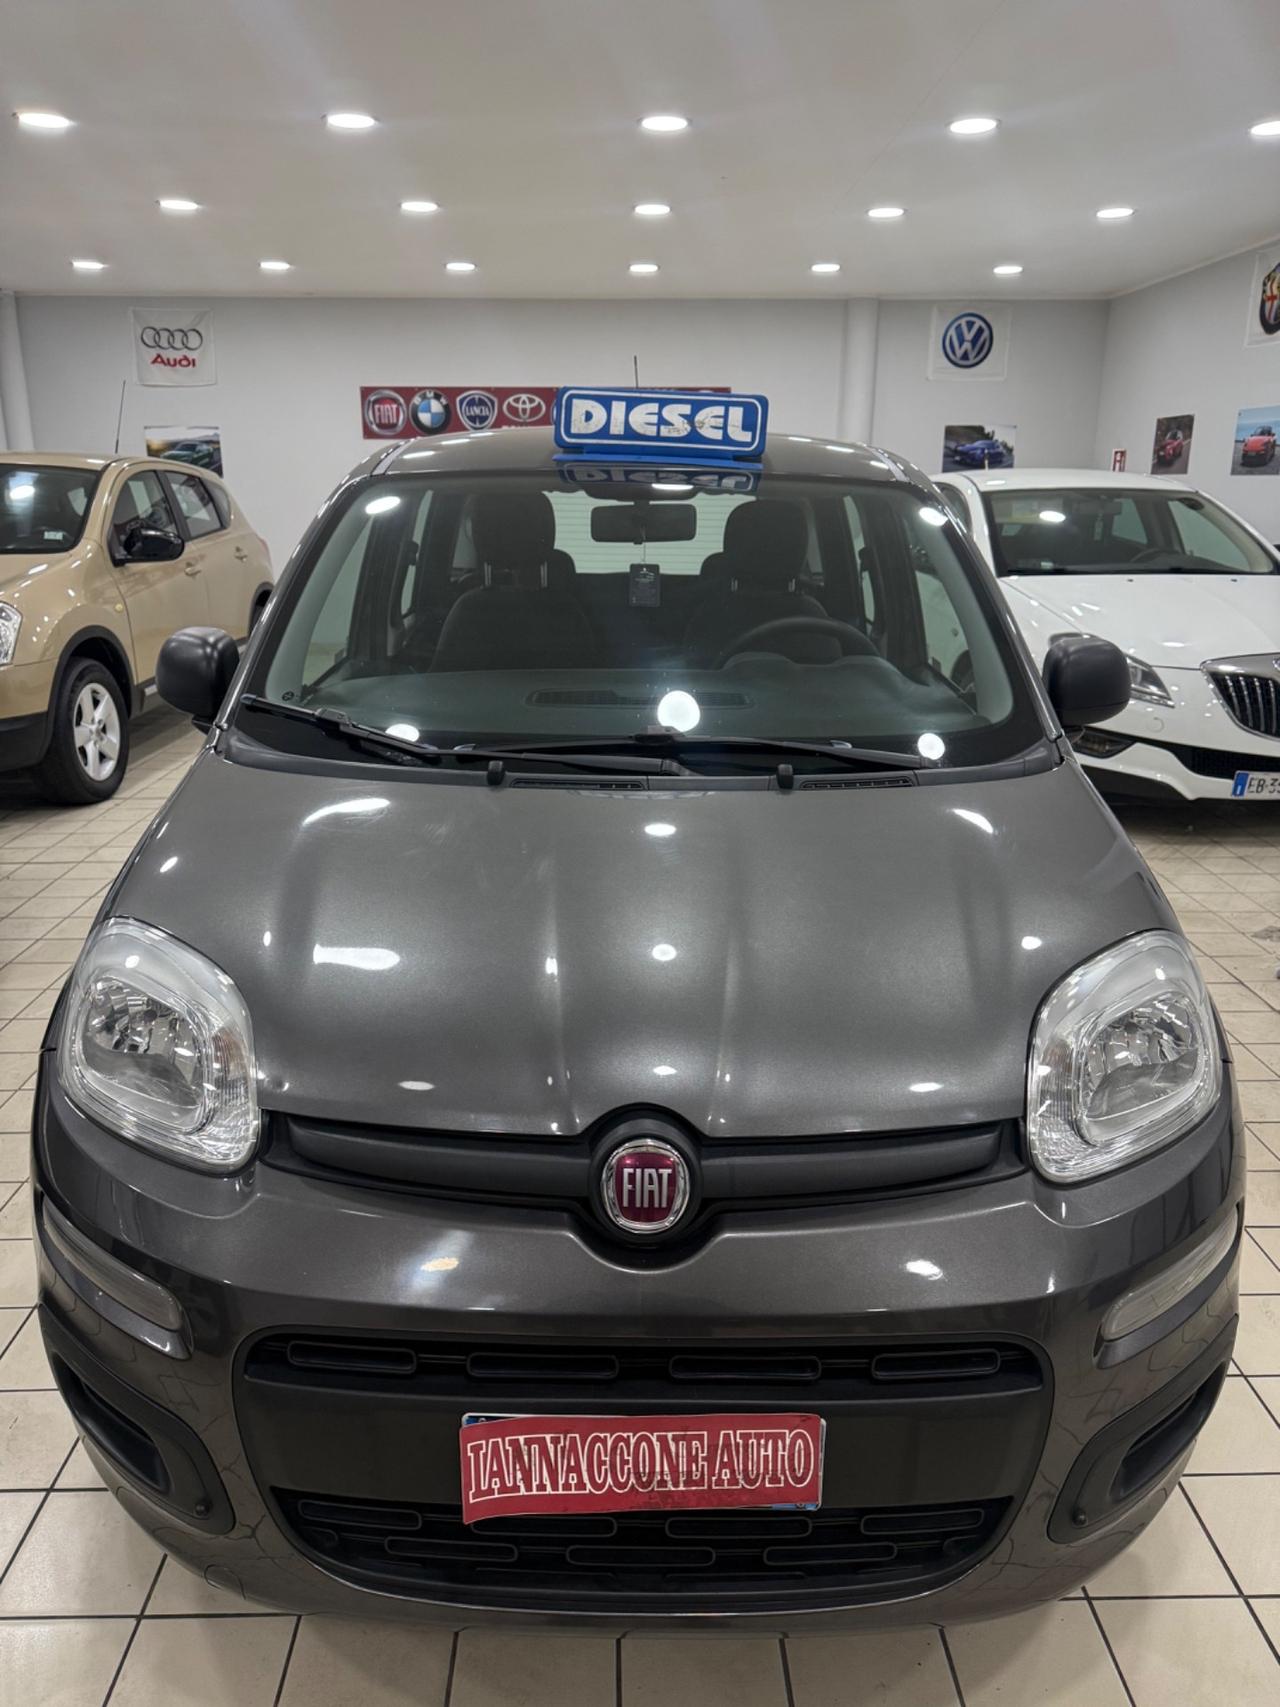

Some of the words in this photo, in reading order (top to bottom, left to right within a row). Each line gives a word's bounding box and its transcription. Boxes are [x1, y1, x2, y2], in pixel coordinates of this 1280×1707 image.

[150, 353, 197, 369] Audi
[374, 404, 398, 424] FIAT
[465, 405, 490, 417] LANCIA
[570, 398, 752, 442] DIESEL
[623, 1168, 672, 1208] FIAT
[467, 1431, 708, 1503] IANNACCONE
[711, 1429, 814, 1489] AUTO
